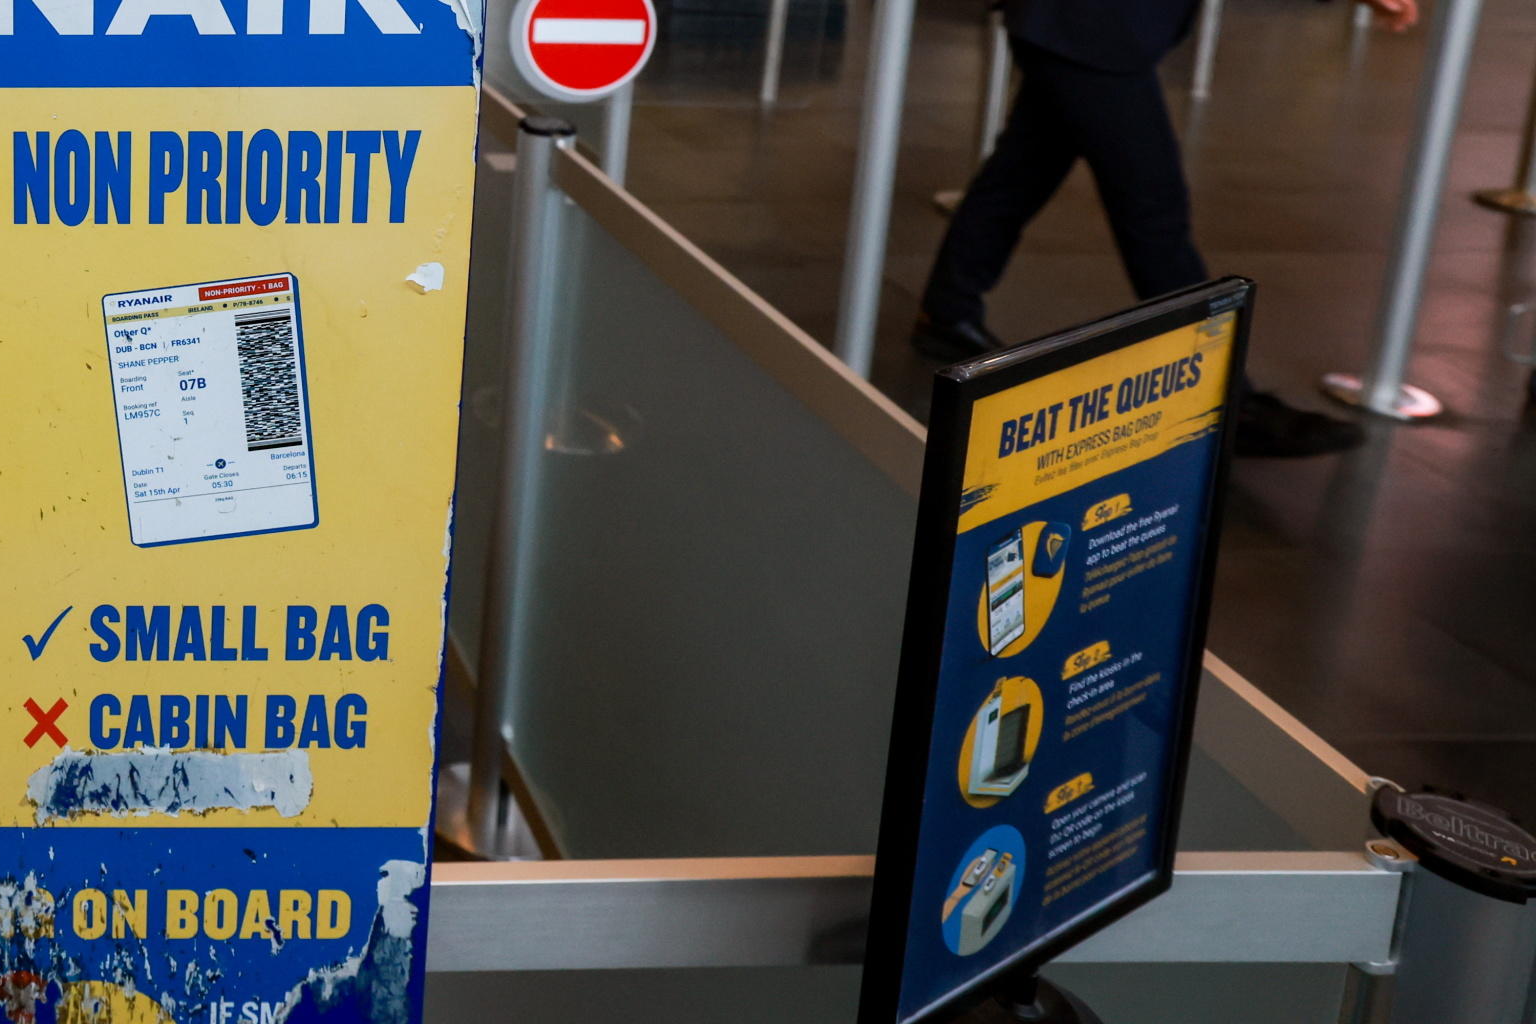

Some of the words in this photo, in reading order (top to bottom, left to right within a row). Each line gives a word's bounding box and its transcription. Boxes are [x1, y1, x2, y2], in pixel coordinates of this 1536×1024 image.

[13, 128, 131, 226] NON
[148, 128, 422, 226] PRIORITY
[204, 284, 256, 297] NON-PRIORITY
[268, 281, 284, 290] BAG
[117, 294, 173, 308] RYANAIR
[111, 314, 142, 322] BOARDING
[188, 305, 213, 313] IRELAND
[114, 328, 138, 338] Other
[115, 345, 132, 354] DUB
[139, 342, 157, 351] BCN
[171, 337, 200, 347] FR6341
[118, 359, 146, 369] SHANE
[147, 355, 179, 365] PEPPER
[120, 375, 147, 384] Boarding
[179, 377, 207, 391] 07B
[121, 384, 144, 393] Front
[123, 402, 147, 411] Booking
[998, 401, 1063, 459] BEAT
[1068, 383, 1113, 433] THE
[1116, 352, 1203, 415] QUEUES
[124, 408, 161, 420] LM957C
[1037, 447, 1064, 471] WITH
[1065, 428, 1112, 460] EXPRESS
[1112, 421, 1134, 443] BAG
[1134, 411, 1162, 435] DROP
[270, 450, 306, 460] Barcelona
[132, 468, 154, 476] Dublin
[134, 490, 147, 498] Sat
[149, 488, 165, 496] 15th
[167, 486, 180, 495] Apr
[1088, 525, 1126, 550] Download
[89, 604, 268, 662] SMALL
[285, 603, 390, 663] BAG
[89, 693, 248, 749] CABIN
[265, 693, 368, 750] BAG
[72, 887, 149, 940] ON
[166, 888, 352, 940] BOARD
[210, 1001, 234, 1024] IF
